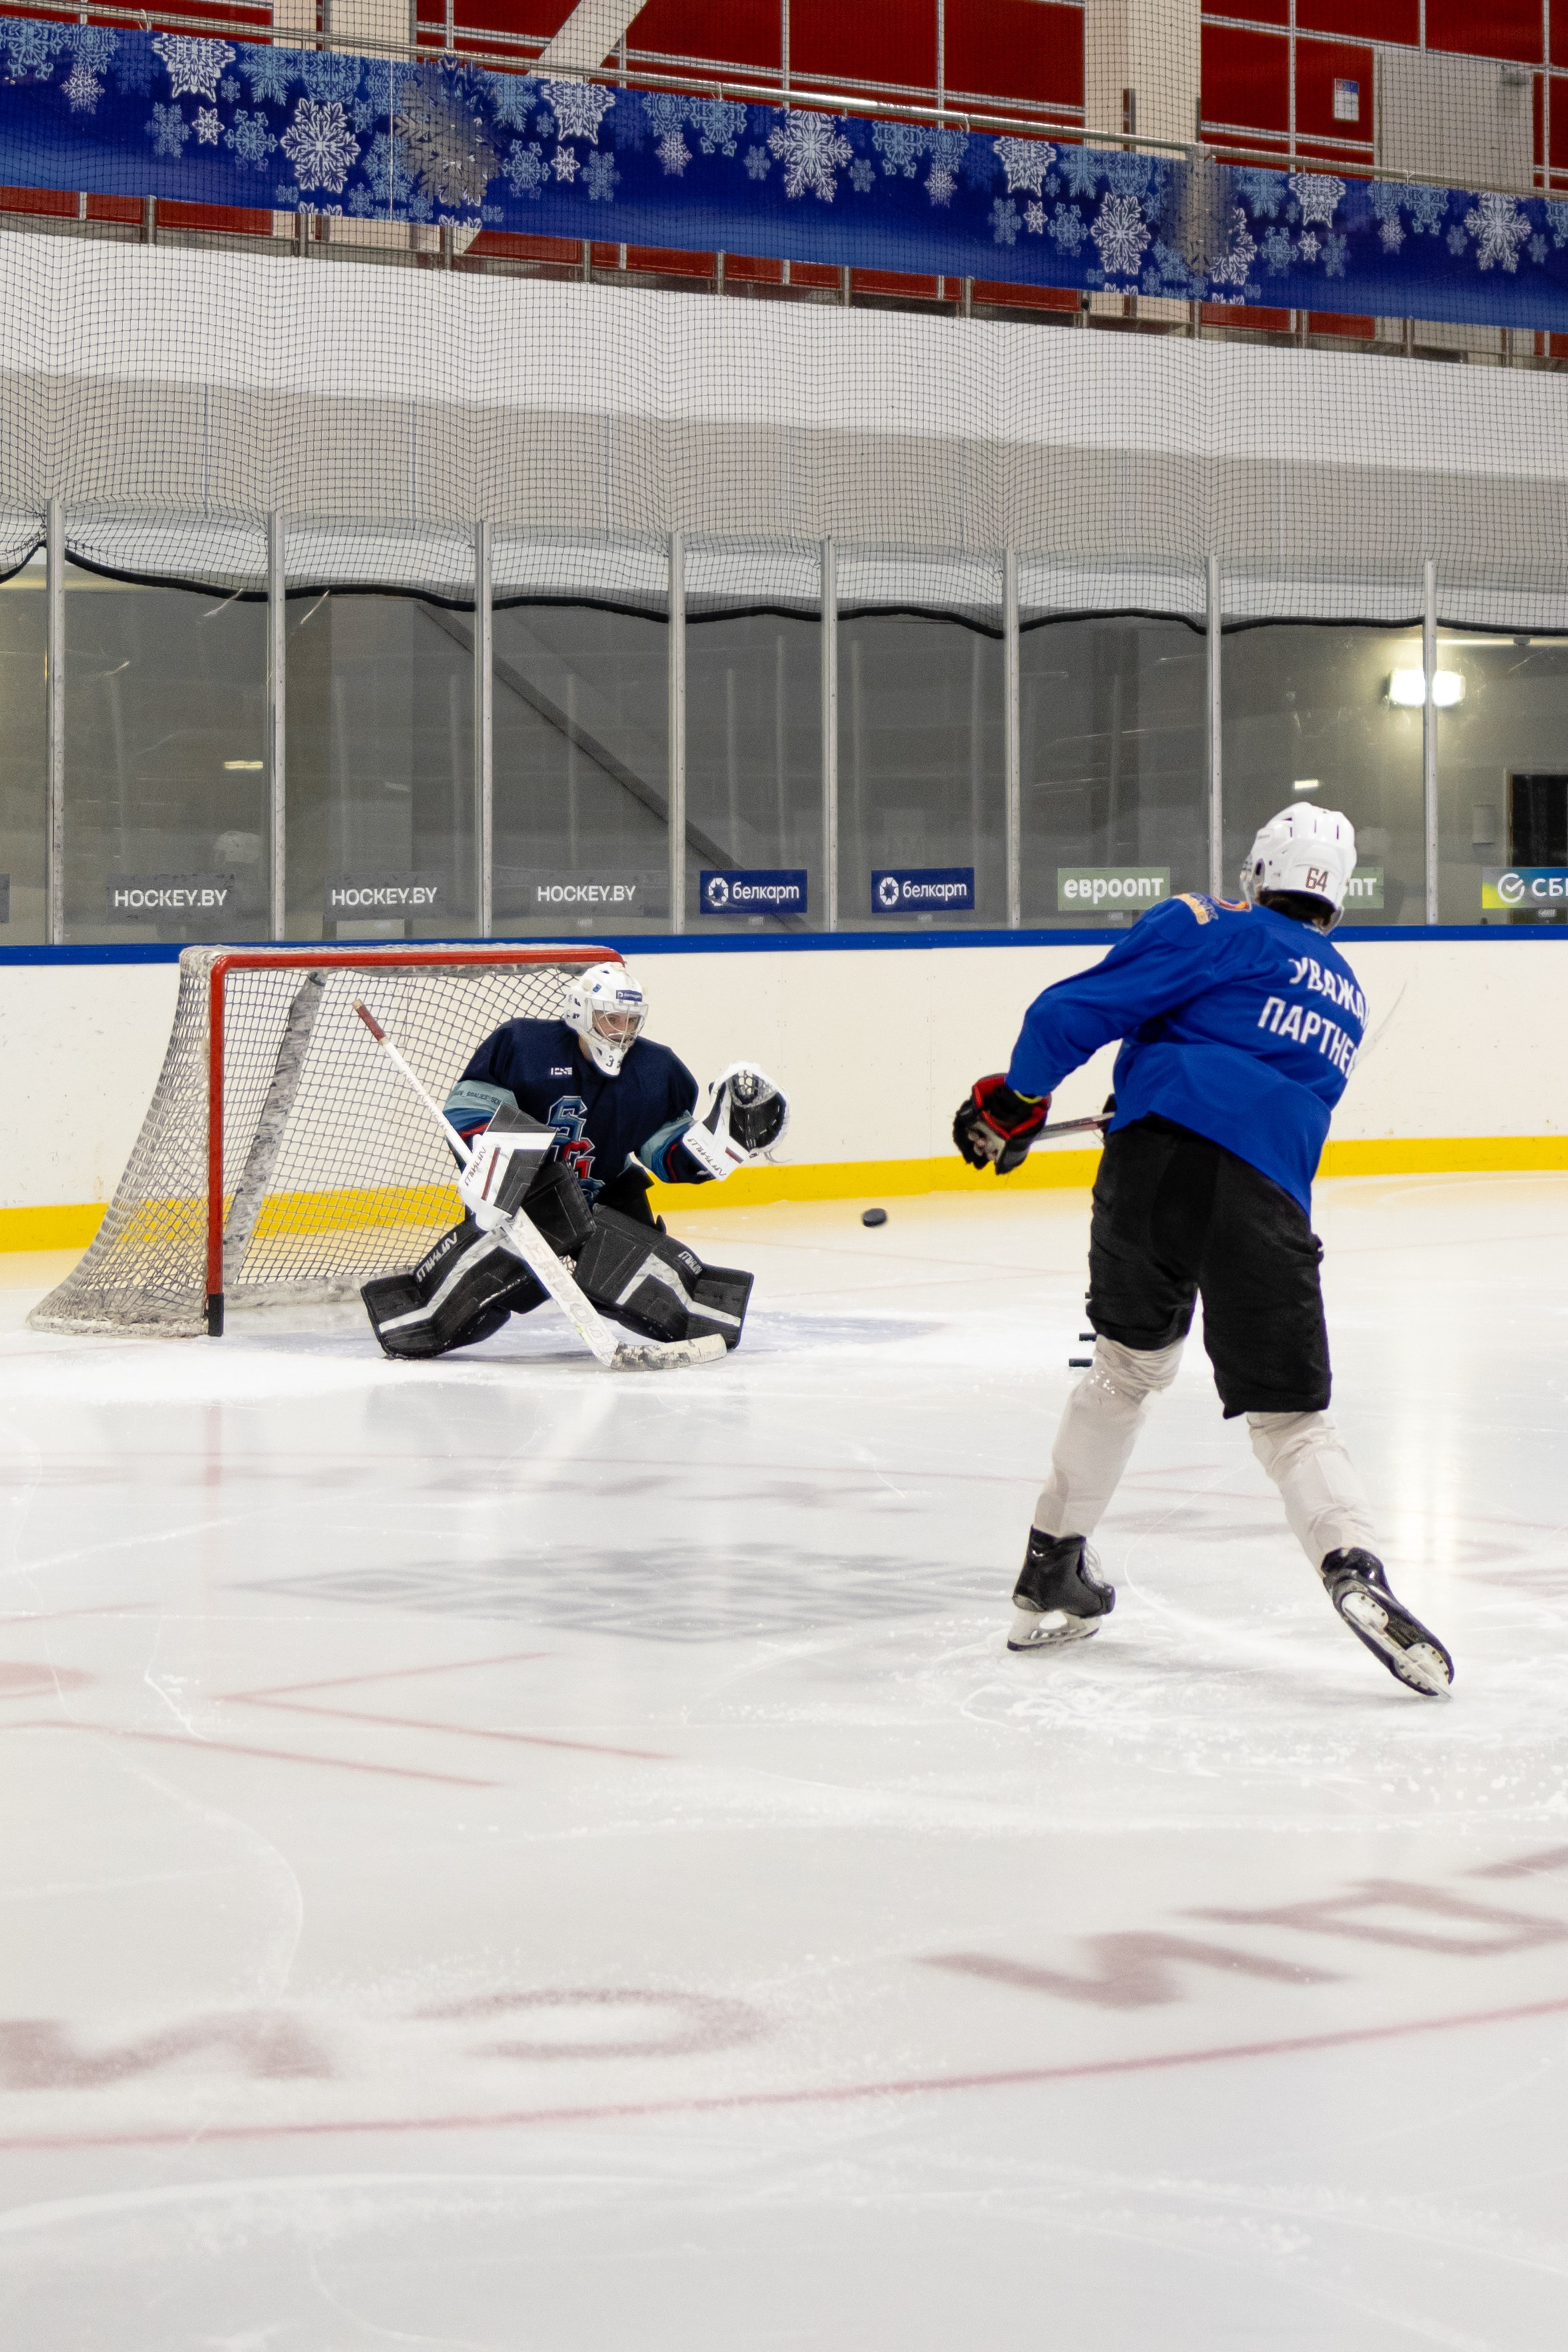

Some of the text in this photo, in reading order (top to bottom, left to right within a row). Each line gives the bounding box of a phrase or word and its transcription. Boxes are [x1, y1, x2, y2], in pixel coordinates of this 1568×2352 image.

[1064, 876, 1165, 903] евроопт
[1305, 867, 1328, 892] 64
[1531, 878, 1568, 896] СБ
[114, 888, 228, 907] HOCKEY.BY
[331, 886, 438, 906] HOCKEY.BY
[537, 884, 636, 902] HOCKEY.BY
[732, 881, 799, 902] белкарт
[902, 880, 968, 902] белкарт
[1288, 956, 1370, 1032] УВАЖА
